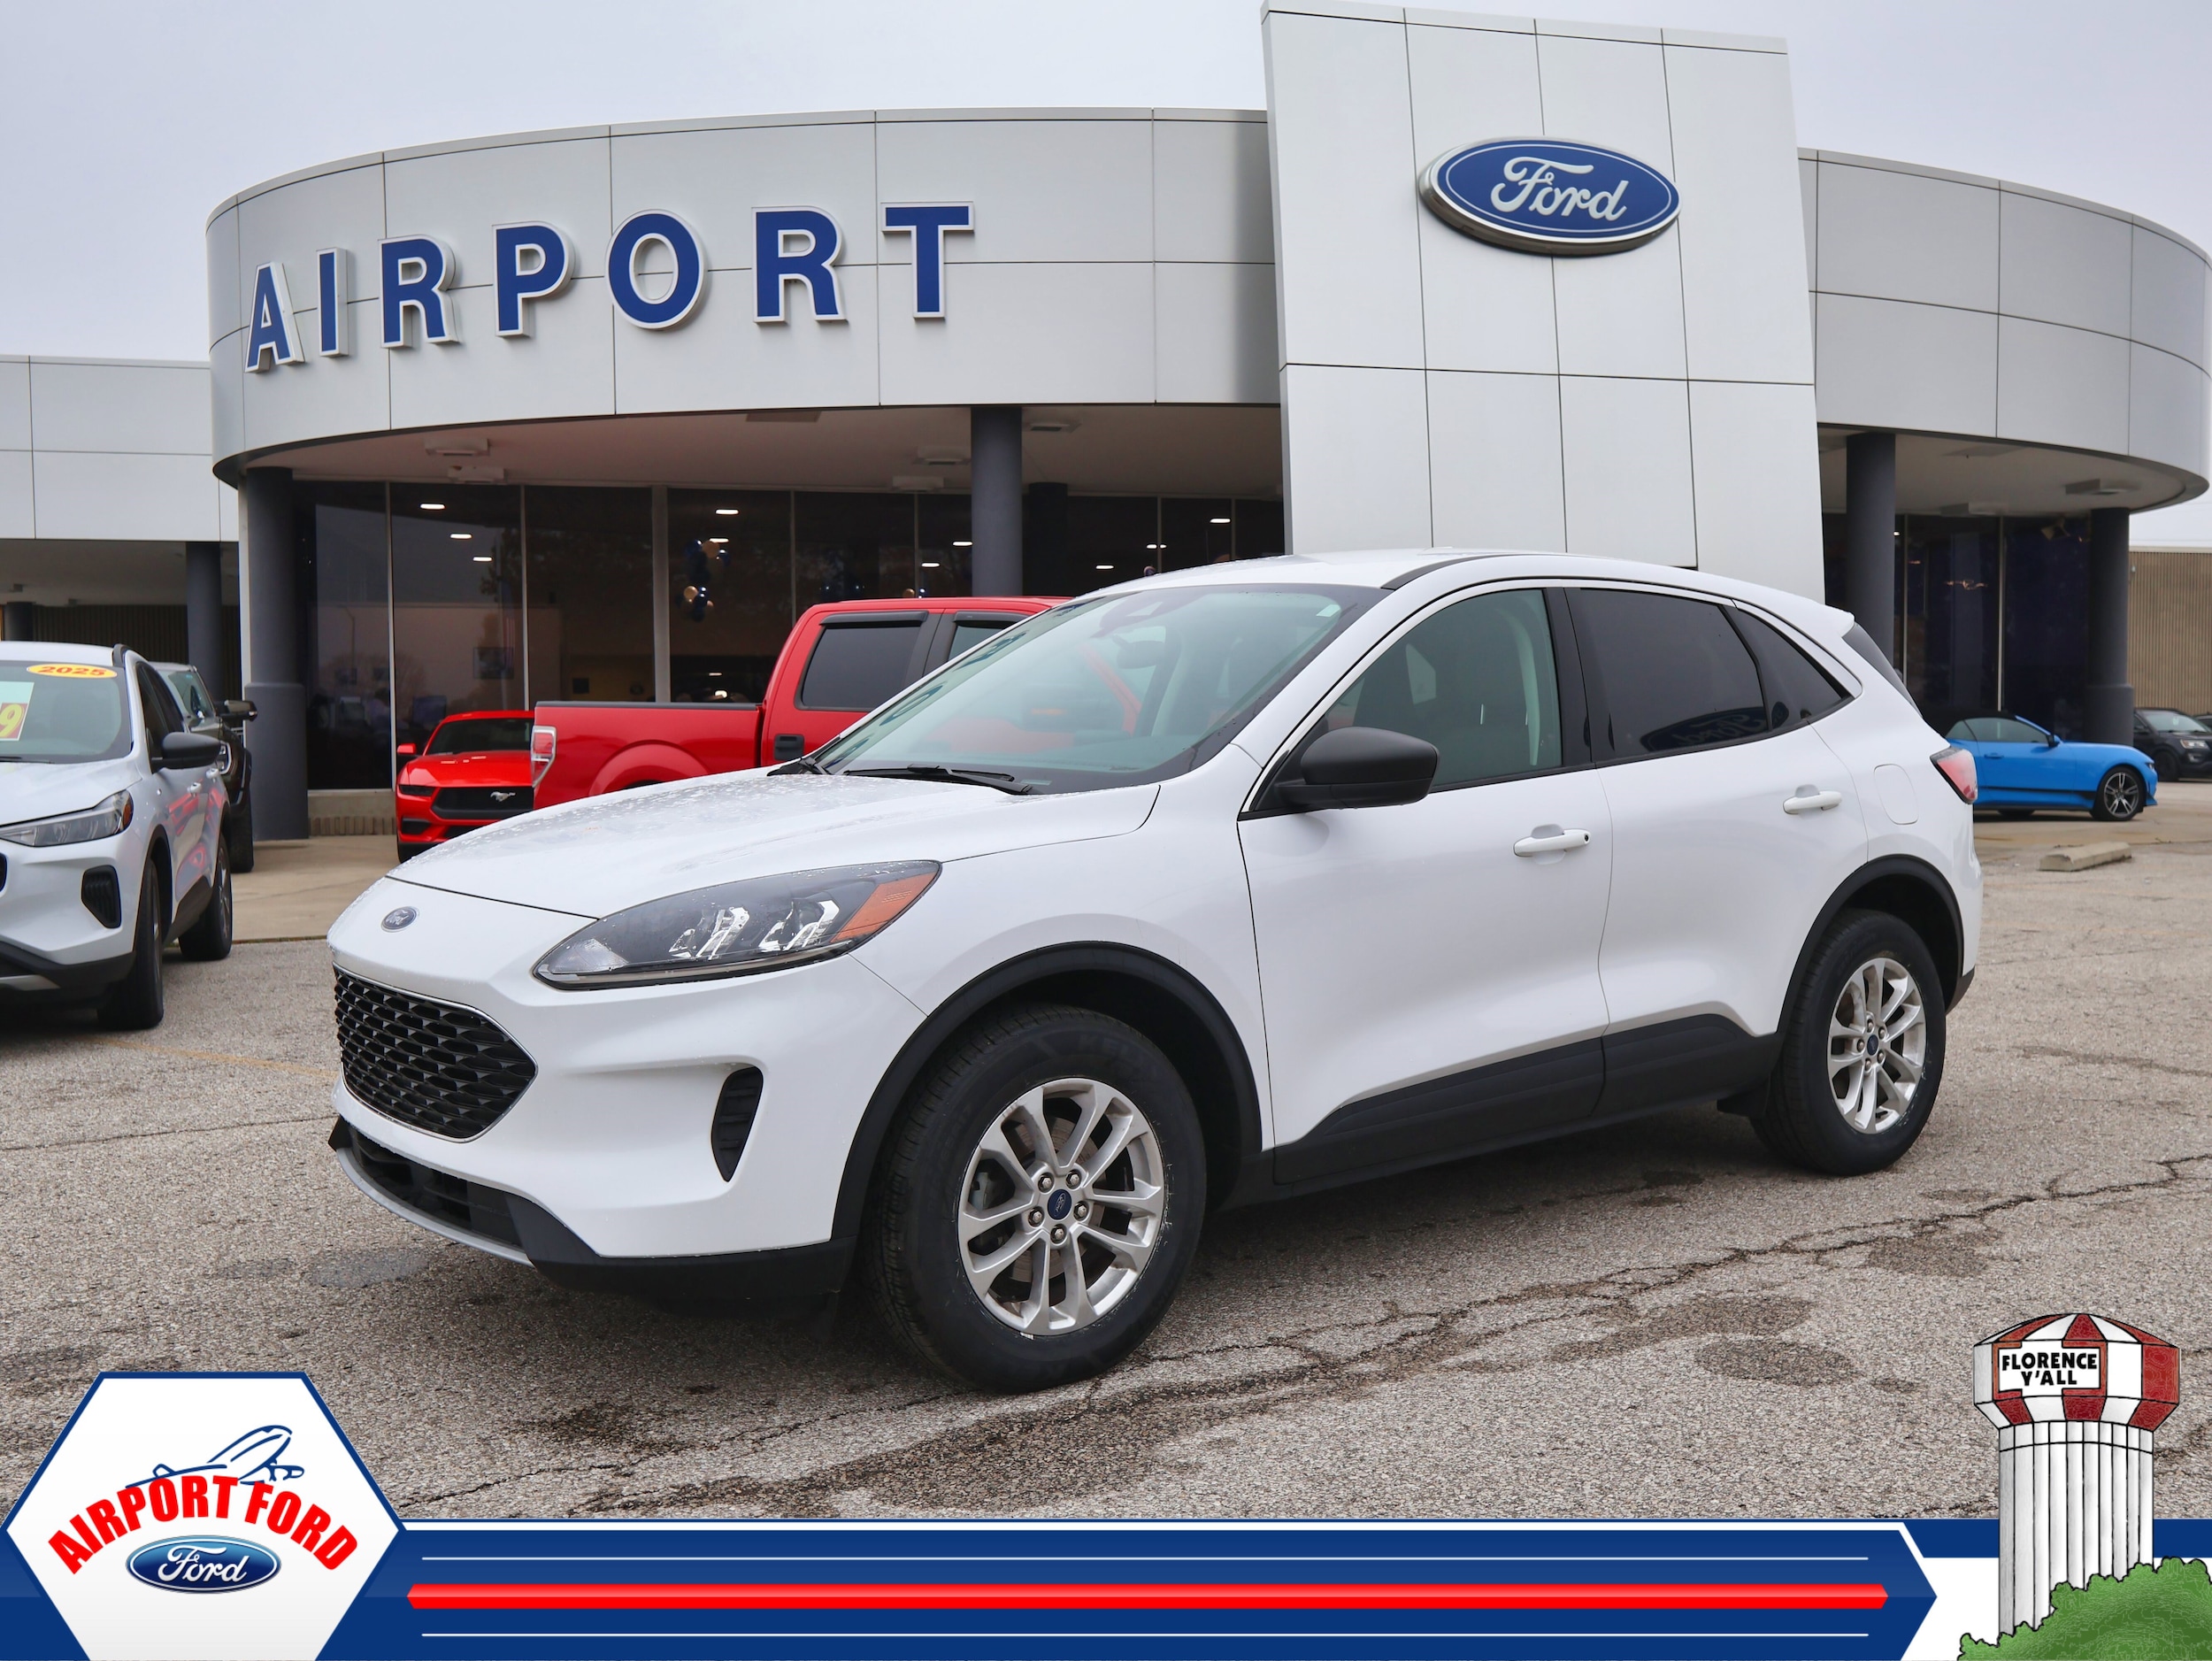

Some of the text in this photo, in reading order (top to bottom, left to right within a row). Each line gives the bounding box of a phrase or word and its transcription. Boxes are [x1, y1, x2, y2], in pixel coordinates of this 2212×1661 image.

[1491, 156, 1629, 221] Ford
[244, 201, 975, 373] AIRPORT
[38, 665, 107, 676] 2025
